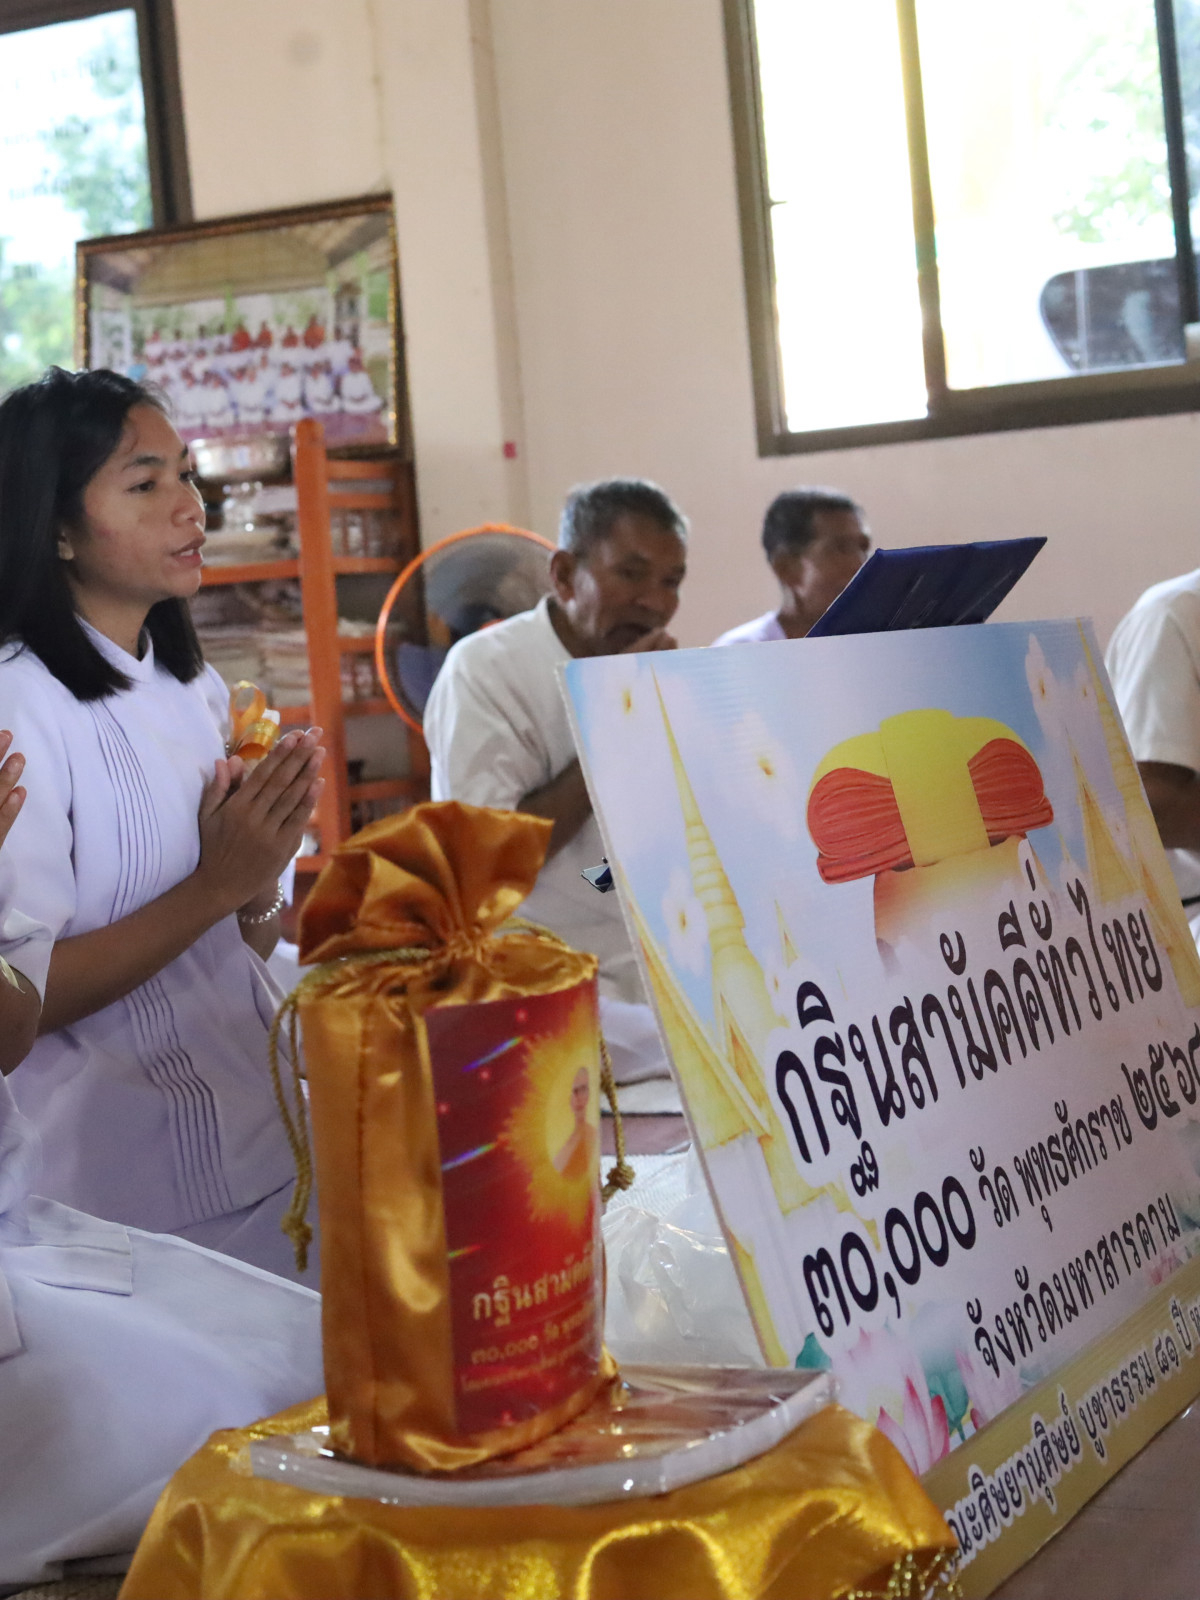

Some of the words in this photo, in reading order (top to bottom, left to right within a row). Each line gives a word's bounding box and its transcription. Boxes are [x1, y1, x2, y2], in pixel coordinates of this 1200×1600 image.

[775, 859, 1163, 1197] กฐินสามัคคีทั่วไทย
[803, 1176, 977, 1337] ๓๐,๐๐๐
[969, 1146, 1020, 1229] วัด
[1014, 1094, 1133, 1232] พุทธศักราช
[967, 1193, 1180, 1378] จังหวัดมหาสารคาม
[947, 1392, 1081, 1557] ณะศิษยานุศิษย์
[1079, 1351, 1155, 1458] บูชาธรรม
